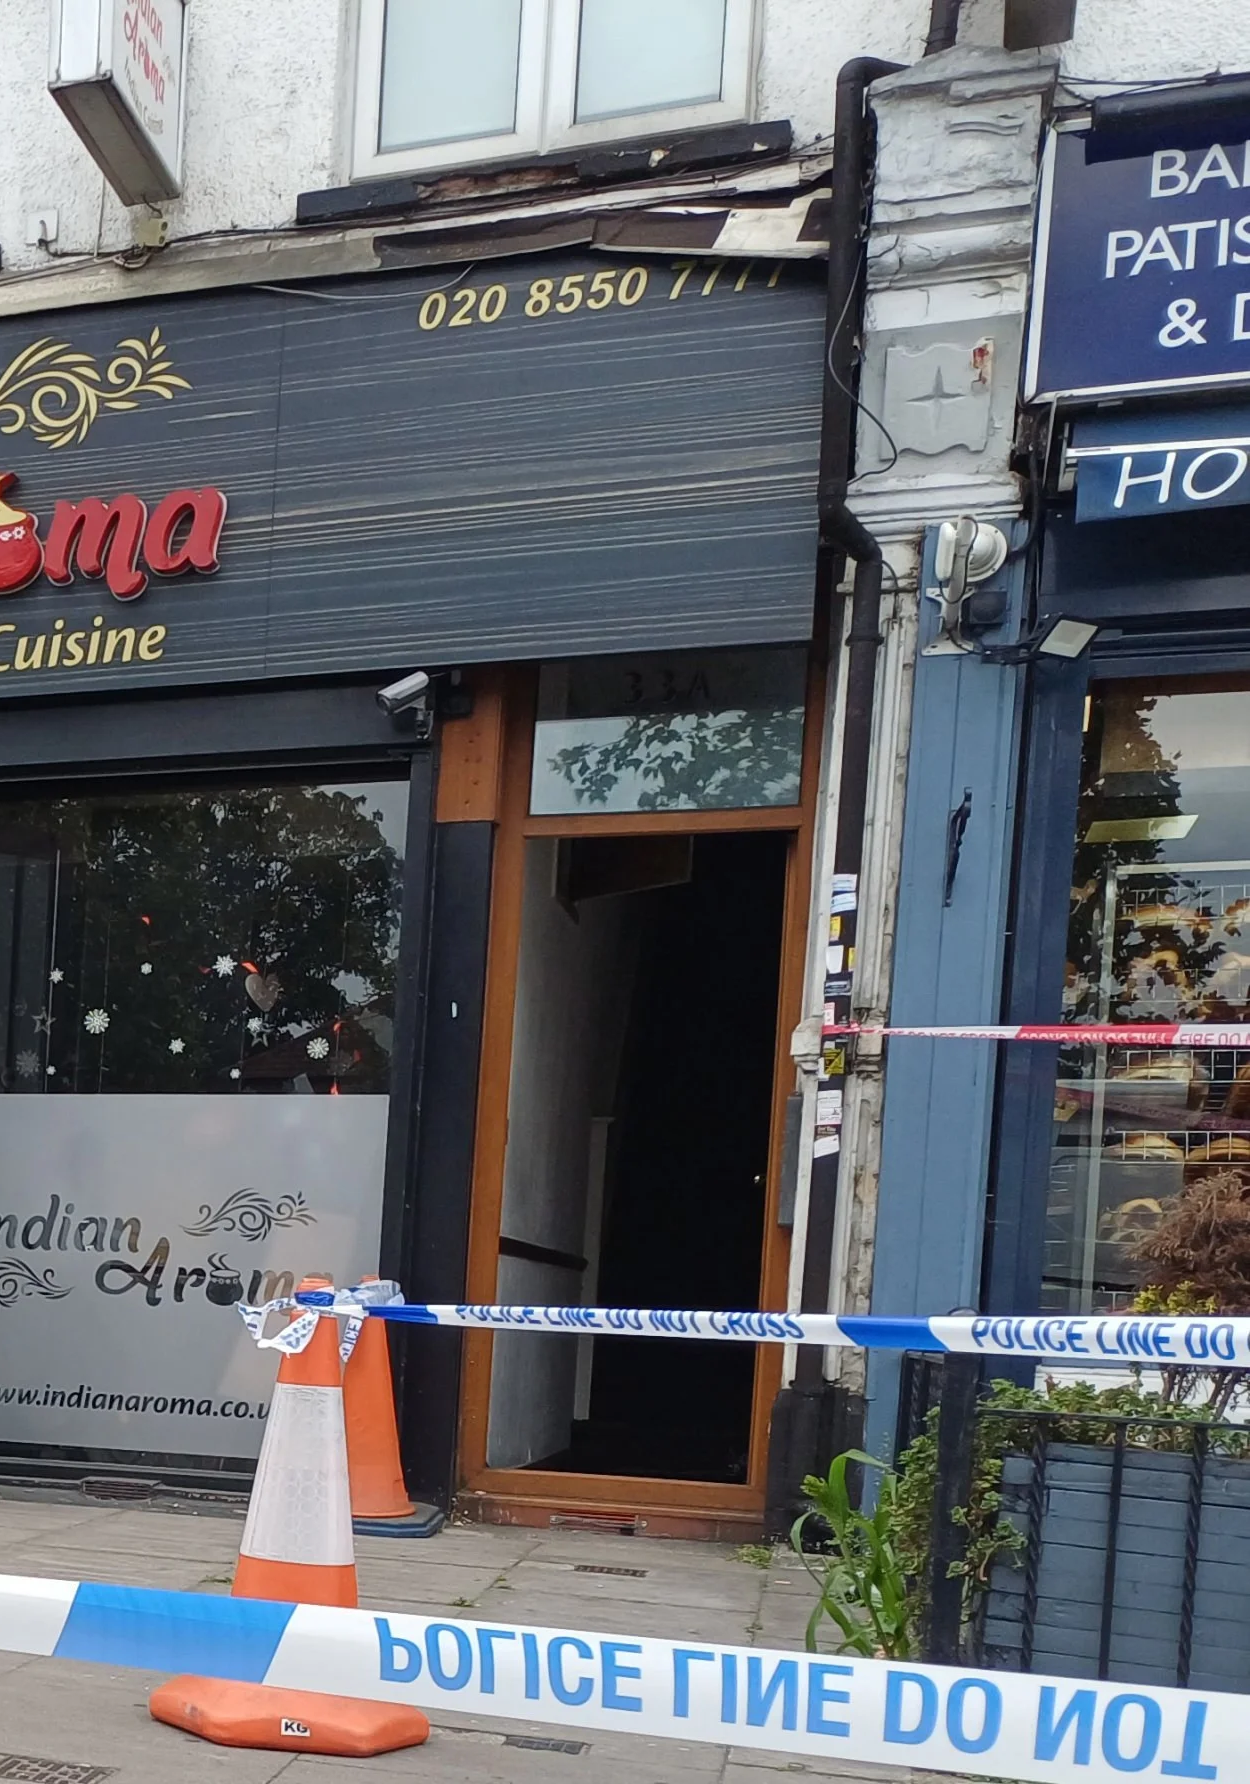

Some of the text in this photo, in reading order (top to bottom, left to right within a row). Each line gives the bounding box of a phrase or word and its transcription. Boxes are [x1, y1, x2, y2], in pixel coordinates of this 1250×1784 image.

[418, 284, 508, 331] 020
[524, 266, 648, 318] 8550
[1158, 298, 1207, 347] &
[1113, 448, 1248, 509] HO
[95, 1236, 334, 1316] Arom
[544, 1306, 603, 1328] LINE
[971, 1318, 1235, 1360] POLICE LINE DO
